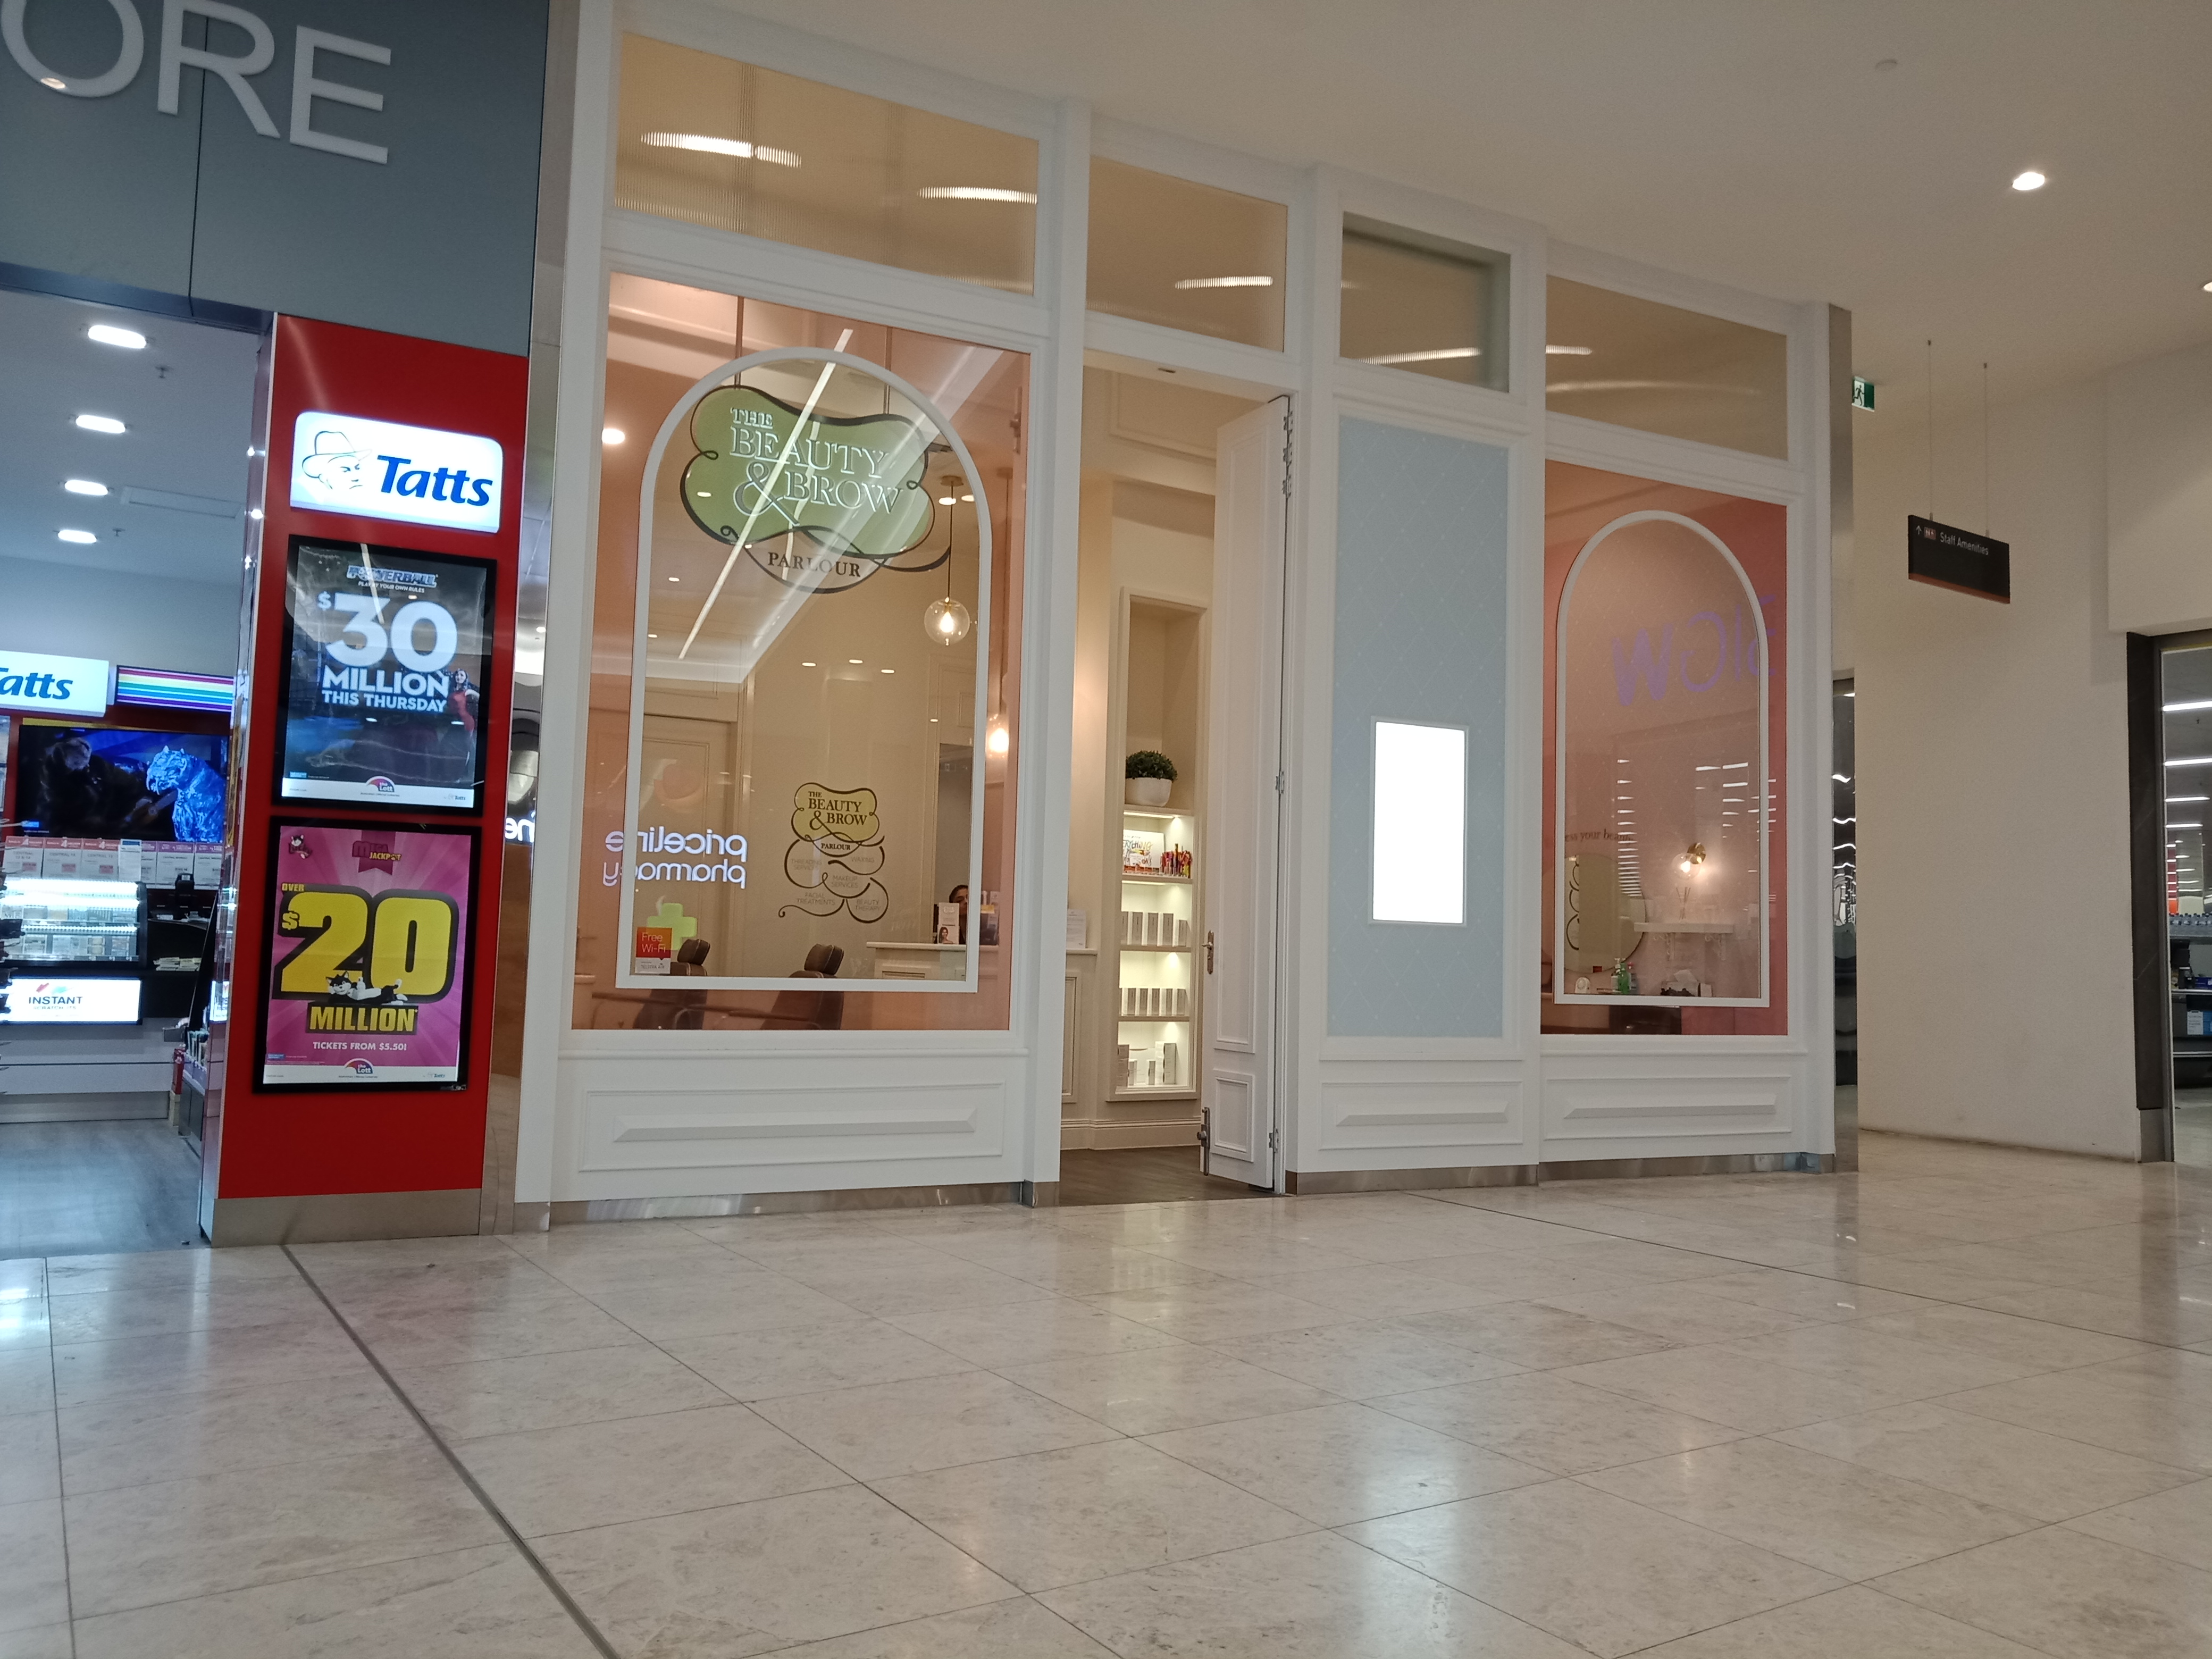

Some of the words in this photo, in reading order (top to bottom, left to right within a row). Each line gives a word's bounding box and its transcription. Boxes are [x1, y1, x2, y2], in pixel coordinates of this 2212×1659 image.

[731, 407, 773, 430] THE
[730, 425, 890, 479] BEAUTY
[377, 455, 493, 507] Tatts
[734, 461, 800, 526] &
[785, 470, 902, 514] BROW
[1940, 532, 1956, 545] Staff
[1957, 537, 1989, 555] Amenities
[768, 551, 861, 578] PARLOUR
[347, 565, 437, 588] POWERBALL
[0, 667, 73, 700] atts
[322, 668, 450, 698] MILLION
[322, 690, 360, 706] THIS
[364, 694, 447, 713] THURSDAY
[808, 798, 862, 812] BEAUTY
[809, 810, 834, 833] &
[827, 812, 868, 826] BROW
[1580, 831, 1602, 842] your
[282, 883, 305, 892] OVER
[641, 944, 666, 953] Wi-Fi
[642, 932, 663, 942] Free
[29, 996, 83, 1004] INSTANT
[310, 1006, 415, 1032] MILLION
[313, 1042, 348, 1050] TICKETS
[350, 1042, 376, 1051] FROM
[379, 1043, 407, 1051] $5.50!
